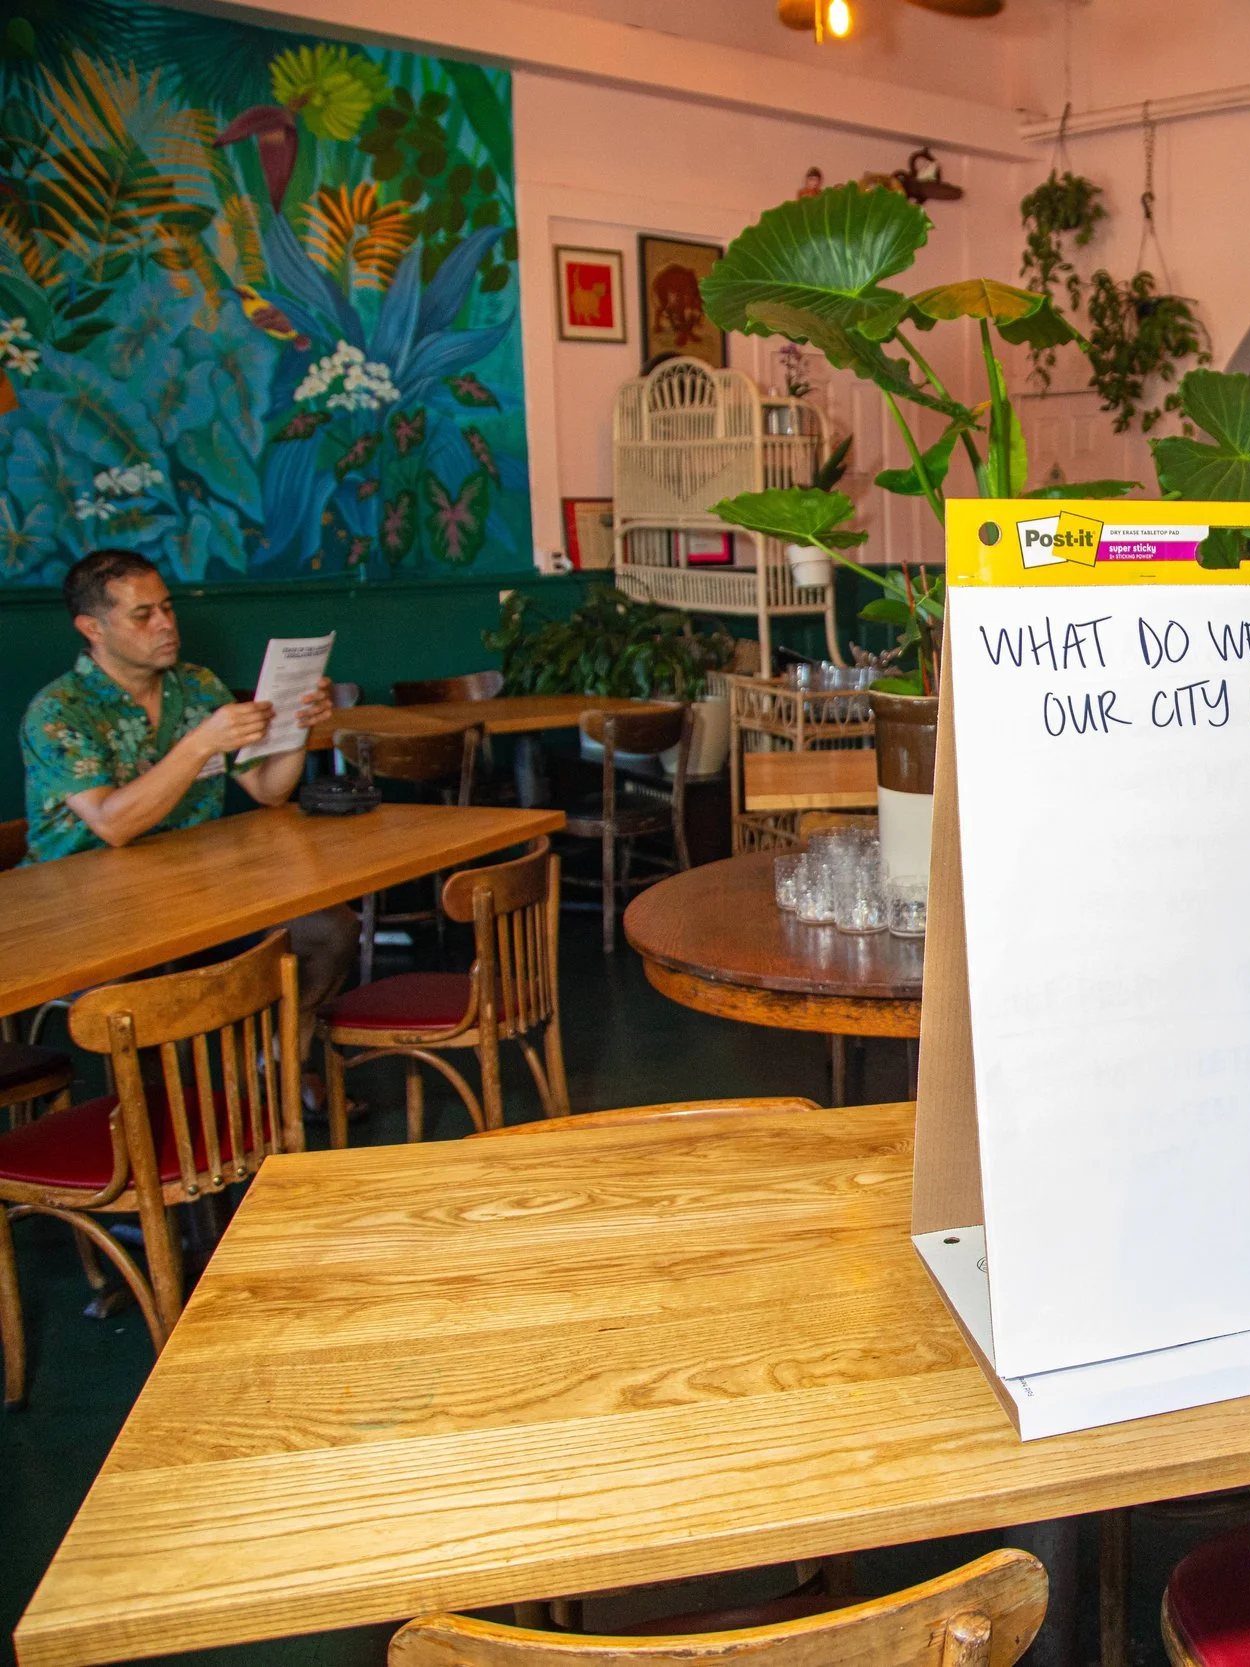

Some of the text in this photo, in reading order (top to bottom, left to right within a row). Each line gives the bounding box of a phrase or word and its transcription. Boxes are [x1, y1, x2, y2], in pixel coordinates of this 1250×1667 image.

[1025, 529, 1094, 548] Post-it
[1109, 543, 1157, 553] super sticky
[979, 616, 1112, 671] WHAT
[1138, 617, 1190, 669] DO
[1044, 690, 1133, 736] OUR
[1151, 679, 1230, 727] CITY
